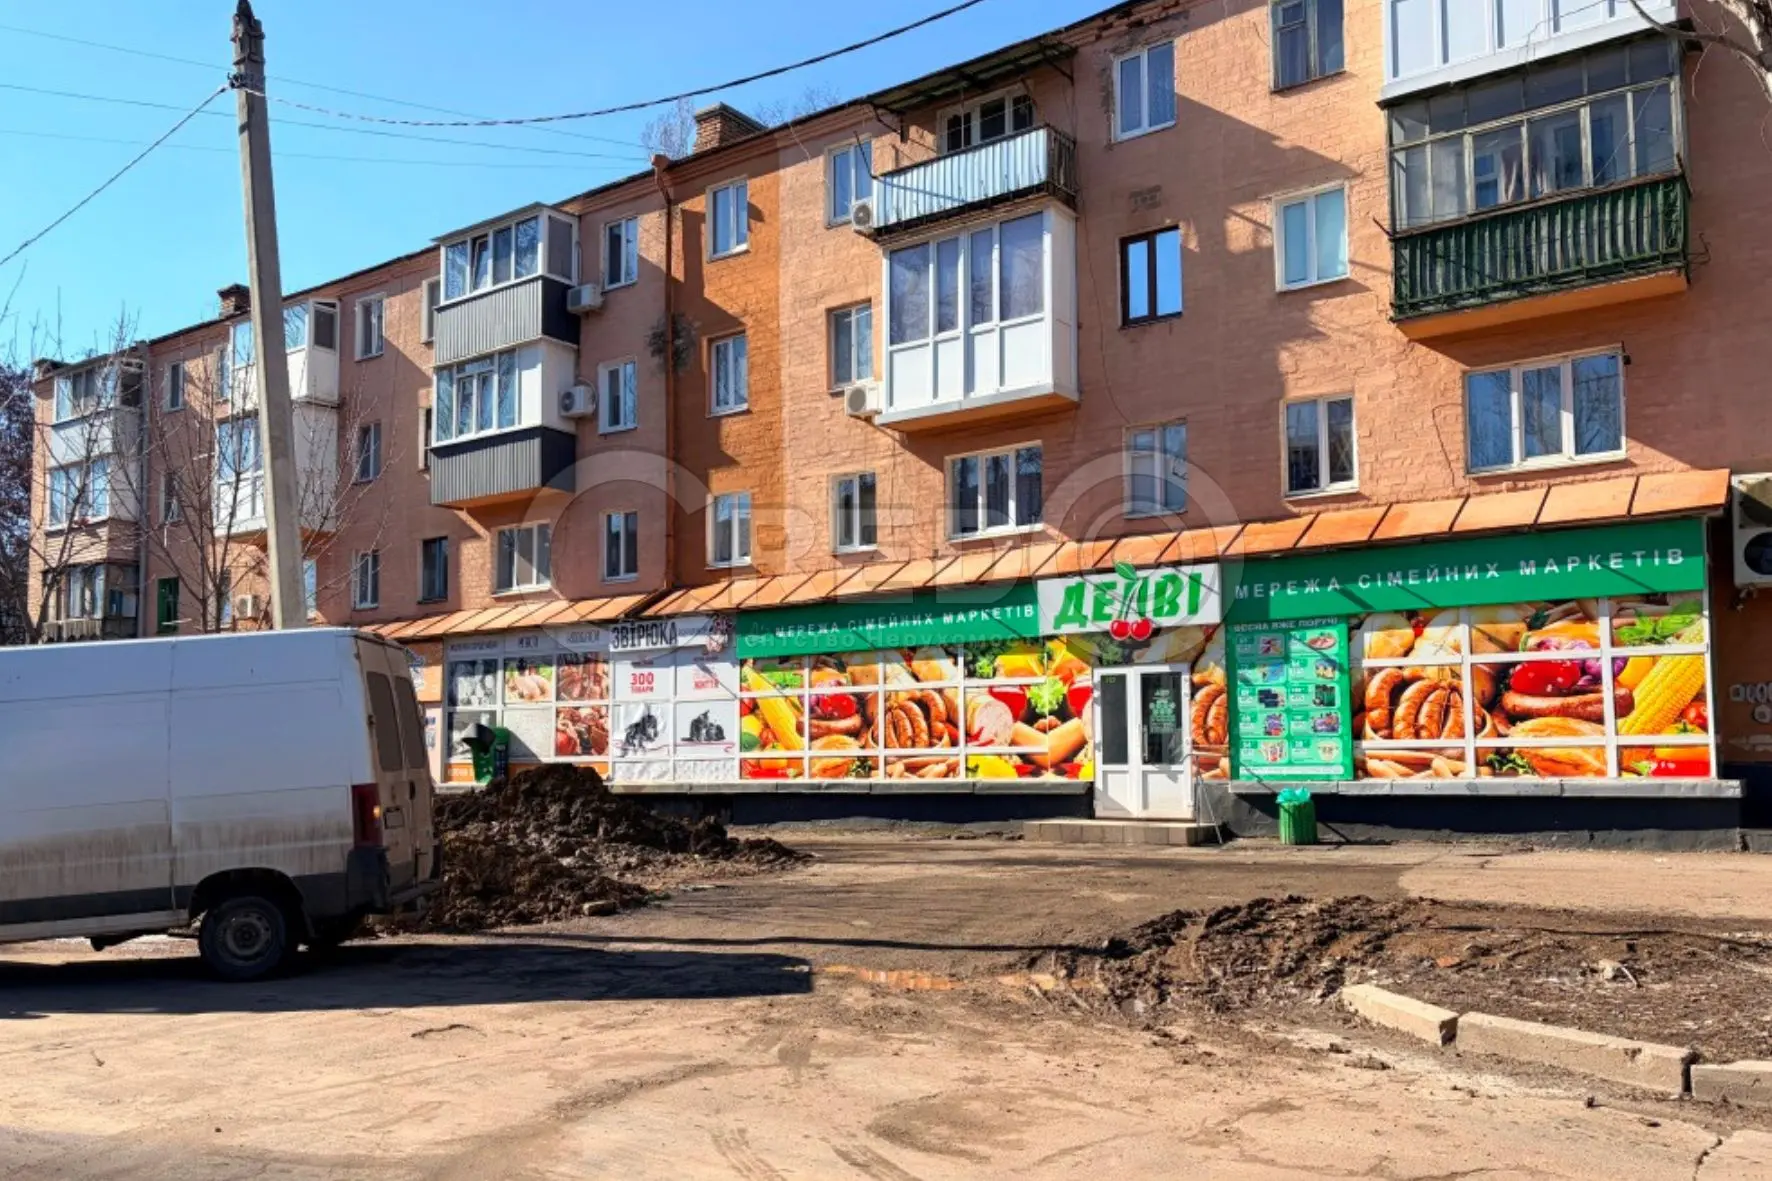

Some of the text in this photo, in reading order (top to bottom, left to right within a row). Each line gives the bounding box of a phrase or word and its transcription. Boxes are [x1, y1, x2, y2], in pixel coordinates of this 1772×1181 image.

[1235, 548, 1685, 600] МЕРЕЖА СІМЕЙНИХ МАРКЕТІВ
[775, 603, 1034, 639] МЕРЕЖА СІМЕЙНИХ МАРКЕТІВ
[1053, 572, 1203, 630] ДЕЛВІ
[610, 620, 678, 649] ЗВІРЮКА
